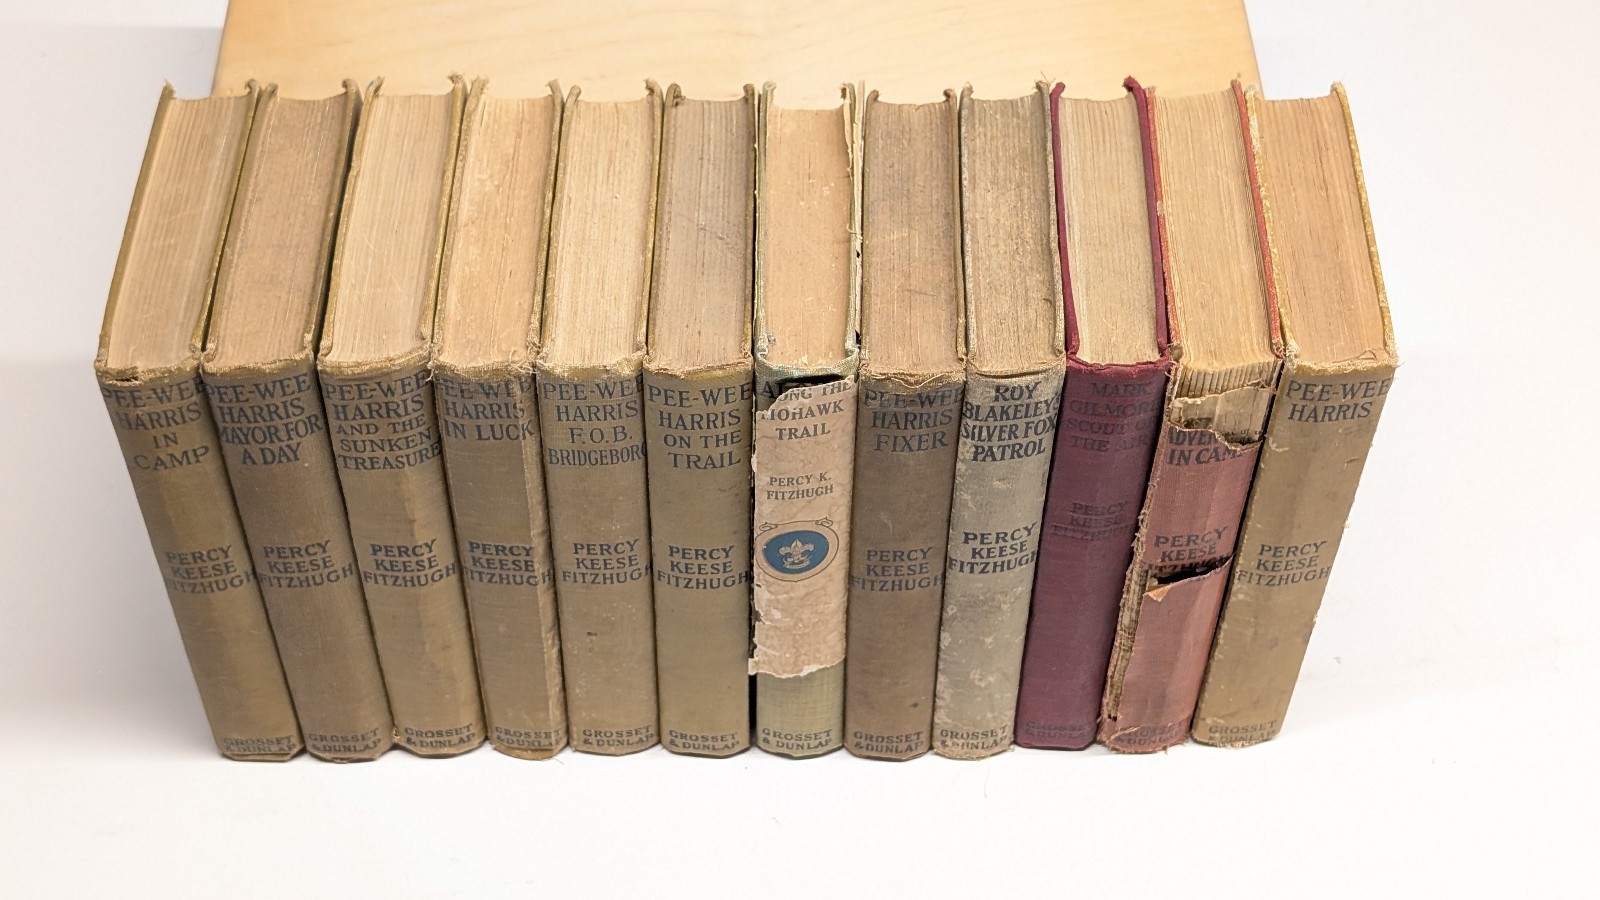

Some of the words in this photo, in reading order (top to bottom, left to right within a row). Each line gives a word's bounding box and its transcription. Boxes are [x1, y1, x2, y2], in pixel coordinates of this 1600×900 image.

[203, 373, 311, 404] PEE-WEE
[323, 369, 429, 401] PEE-WEE
[647, 382, 751, 408] PEE-WEE
[821, 381, 852, 397] THE
[993, 381, 1043, 402] ROY
[1091, 381, 1152, 398] MARK
[1285, 377, 1393, 402] PEE-WEE
[116, 402, 201, 431] HARRIS
[219, 397, 306, 424] HARRIS
[331, 393, 425, 422] HARRIS
[442, 398, 525, 420] HARRIS
[556, 400, 639, 422] HARRIS
[1287, 401, 1374, 424] HARRIS
[336, 423, 379, 436] AND
[388, 413, 426, 434] THE
[658, 408, 741, 431] HARRIS
[871, 409, 953, 431] HARRIS
[961, 421, 1020, 443] SILVER
[1021, 414, 1058, 440] FOX
[1066, 417, 1126, 436] SCOUT
[218, 424, 283, 446] MAYOR
[285, 414, 324, 442] FOR
[340, 426, 433, 454] SUNKEN
[443, 419, 467, 439] IN
[475, 419, 535, 442] LUCK
[569, 425, 633, 444] F.O.B.
[663, 433, 692, 449] ON
[699, 429, 743, 449] THE
[775, 422, 831, 441] TRAIL
[153, 432, 179, 449] IN
[873, 431, 949, 453] FIXER
[971, 438, 1047, 463] PATROL
[1070, 435, 1110, 453] THE
[134, 445, 210, 470] CAMP
[241, 448, 259, 466] A
[261, 442, 303, 466] DAY
[337, 441, 441, 471] TREASURE
[667, 450, 741, 469] TRAIL
[1168, 448, 1193, 466] IN
[1195, 445, 1243, 465] CAM
[769, 474, 814, 487] PERCY
[820, 471, 832, 482] K.
[766, 484, 834, 500] FITZHUGH
[961, 521, 1038, 546] PERCY
[1154, 525, 1229, 548] PERCY
[166, 545, 233, 565] PERCY
[262, 540, 331, 560] PERCY
[369, 538, 438, 558] PERCY
[467, 540, 535, 557] PERCY
[572, 538, 640, 556] PERCY
[667, 544, 736, 561] PERCY
[865, 546, 935, 563] PERCY
[970, 539, 1029, 561] KEESE
[1160, 542, 1217, 563] KEESE
[1258, 540, 1328, 559] PERCY
[171, 560, 238, 581] KEESE
[266, 555, 336, 574] KEESE
[373, 554, 439, 573] KEESE
[470, 555, 536, 572] KEESE
[575, 554, 640, 571] KEESE
[669, 560, 734, 575] KEESE
[865, 562, 930, 578] KEESE
[1255, 555, 1320, 572] KEESE
[166, 566, 257, 594] ITZHUGH
[257, 562, 355, 589] FITZHUGH
[362, 562, 457, 588] FITZHUGH
[656, 568, 750, 590] FITZHUGH
[850, 572, 947, 593] FITZHUGH
[1238, 565, 1333, 587] FITZHUGH
[308, 728, 380, 743] GROSSET
[404, 722, 474, 739] GROSSET
[494, 725, 563, 739] GROSSET
[582, 724, 652, 739] GROSSET
[669, 729, 739, 743] GROSSET
[762, 727, 833, 742] GROSSET
[853, 730, 924, 744] GROSSET
[940, 723, 1008, 740] GROSSET
[1208, 719, 1278, 735] GROSSET
[223, 734, 294, 747] GROSSET
[420, 732, 476, 748] DUNLAP
[596, 733, 655, 748] DUNLAP
[682, 740, 740, 751] DUNLAP
[775, 737, 833, 750] DUNLAP
